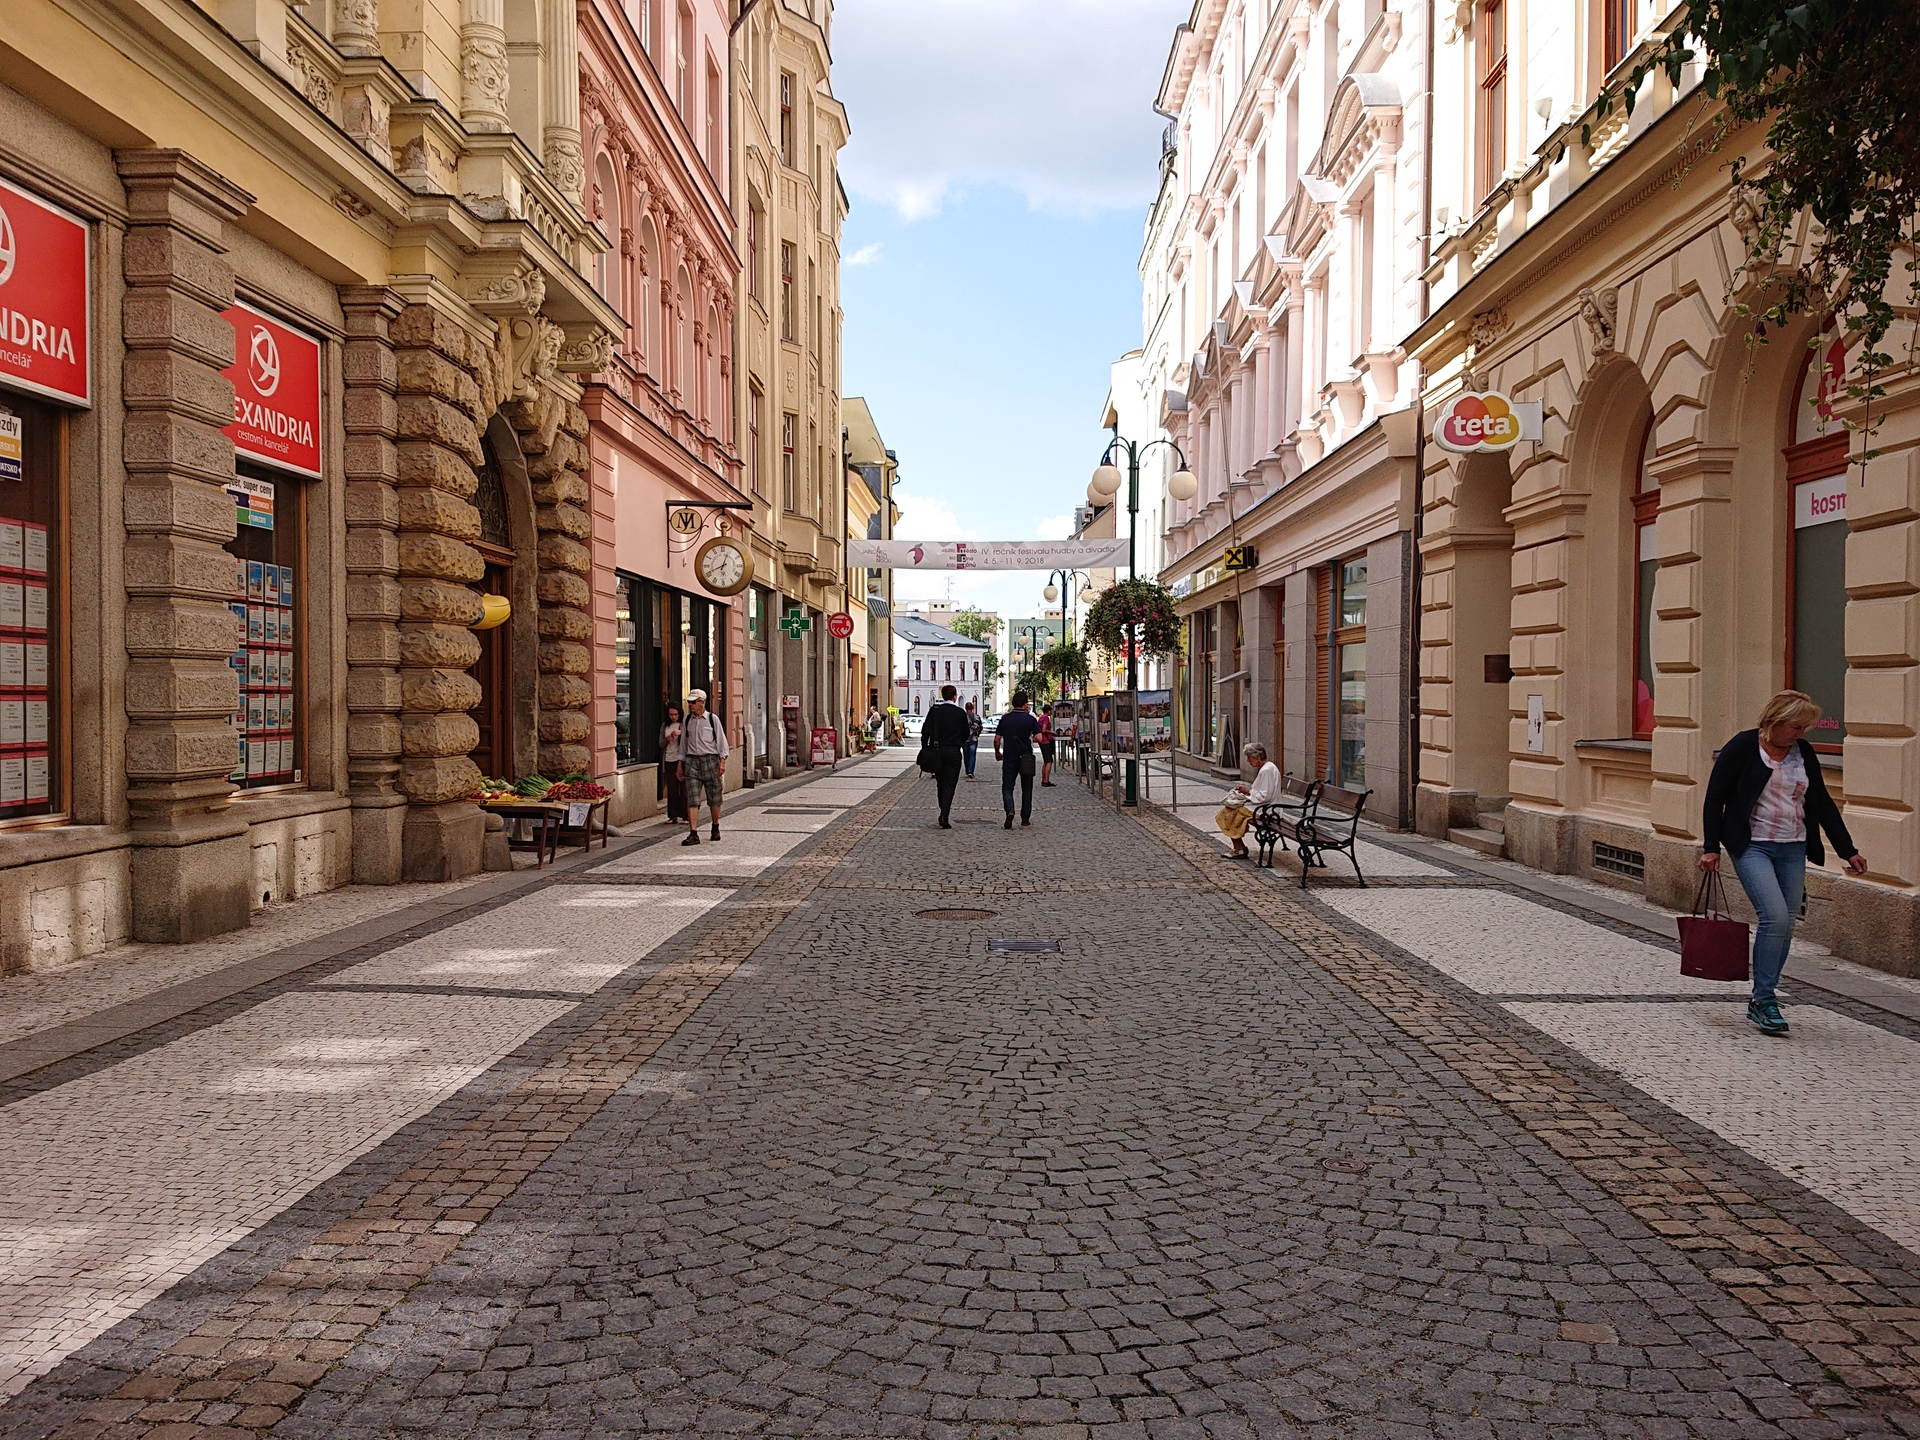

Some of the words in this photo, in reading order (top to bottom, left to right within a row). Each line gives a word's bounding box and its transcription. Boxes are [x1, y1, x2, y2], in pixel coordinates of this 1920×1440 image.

[0, 349, 32, 368] ncelář
[0, 418, 18, 436] zdy
[1453, 414, 1511, 436] teta
[237, 429, 263, 445] cestovní
[264, 435, 289, 454] kancelář
[1811, 492, 1847, 516] kosm
[1018, 547, 1049, 555] festivalu
[1051, 547, 1076, 556] hudby
